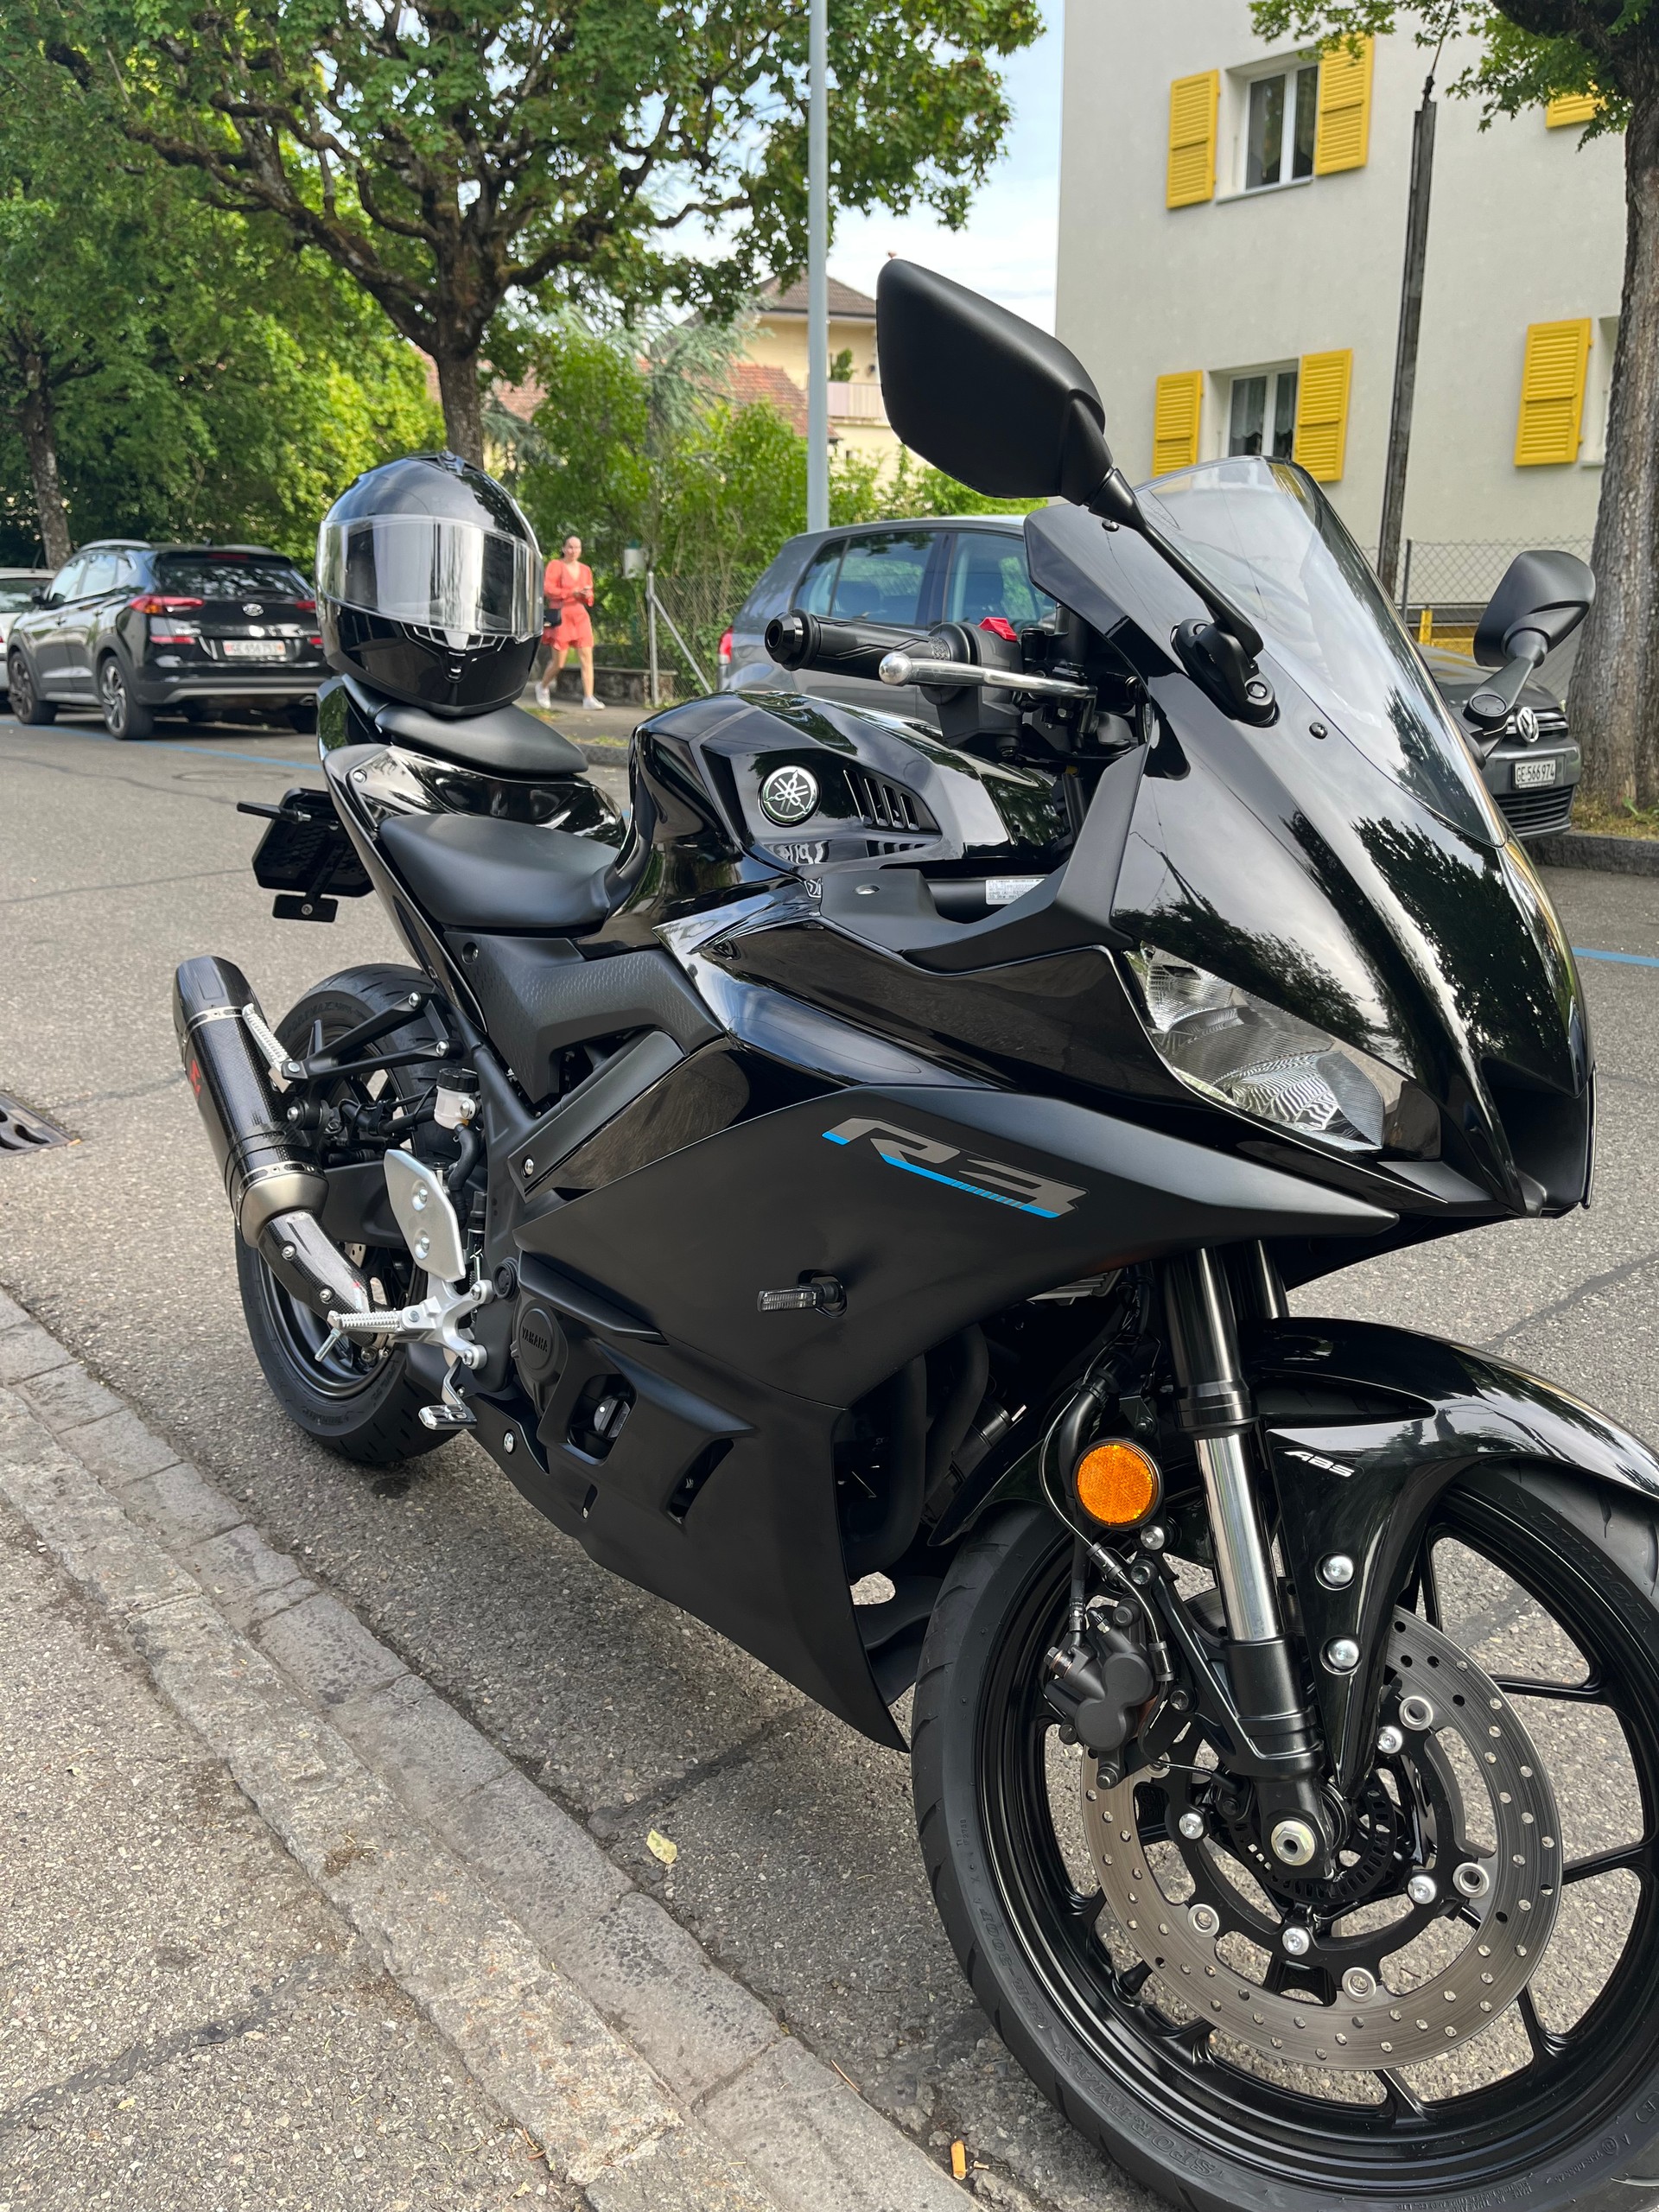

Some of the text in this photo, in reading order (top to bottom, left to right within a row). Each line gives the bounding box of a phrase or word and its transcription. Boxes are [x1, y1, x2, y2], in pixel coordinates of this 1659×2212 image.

[821, 1116, 1087, 1218] R3
[521, 1325, 549, 1353] YAMAHA
[1284, 1451, 1356, 1478] ABS
[1530, 1512, 1652, 1623] DUNLOP
[1054, 2043, 1216, 2177] SPORTMAX
